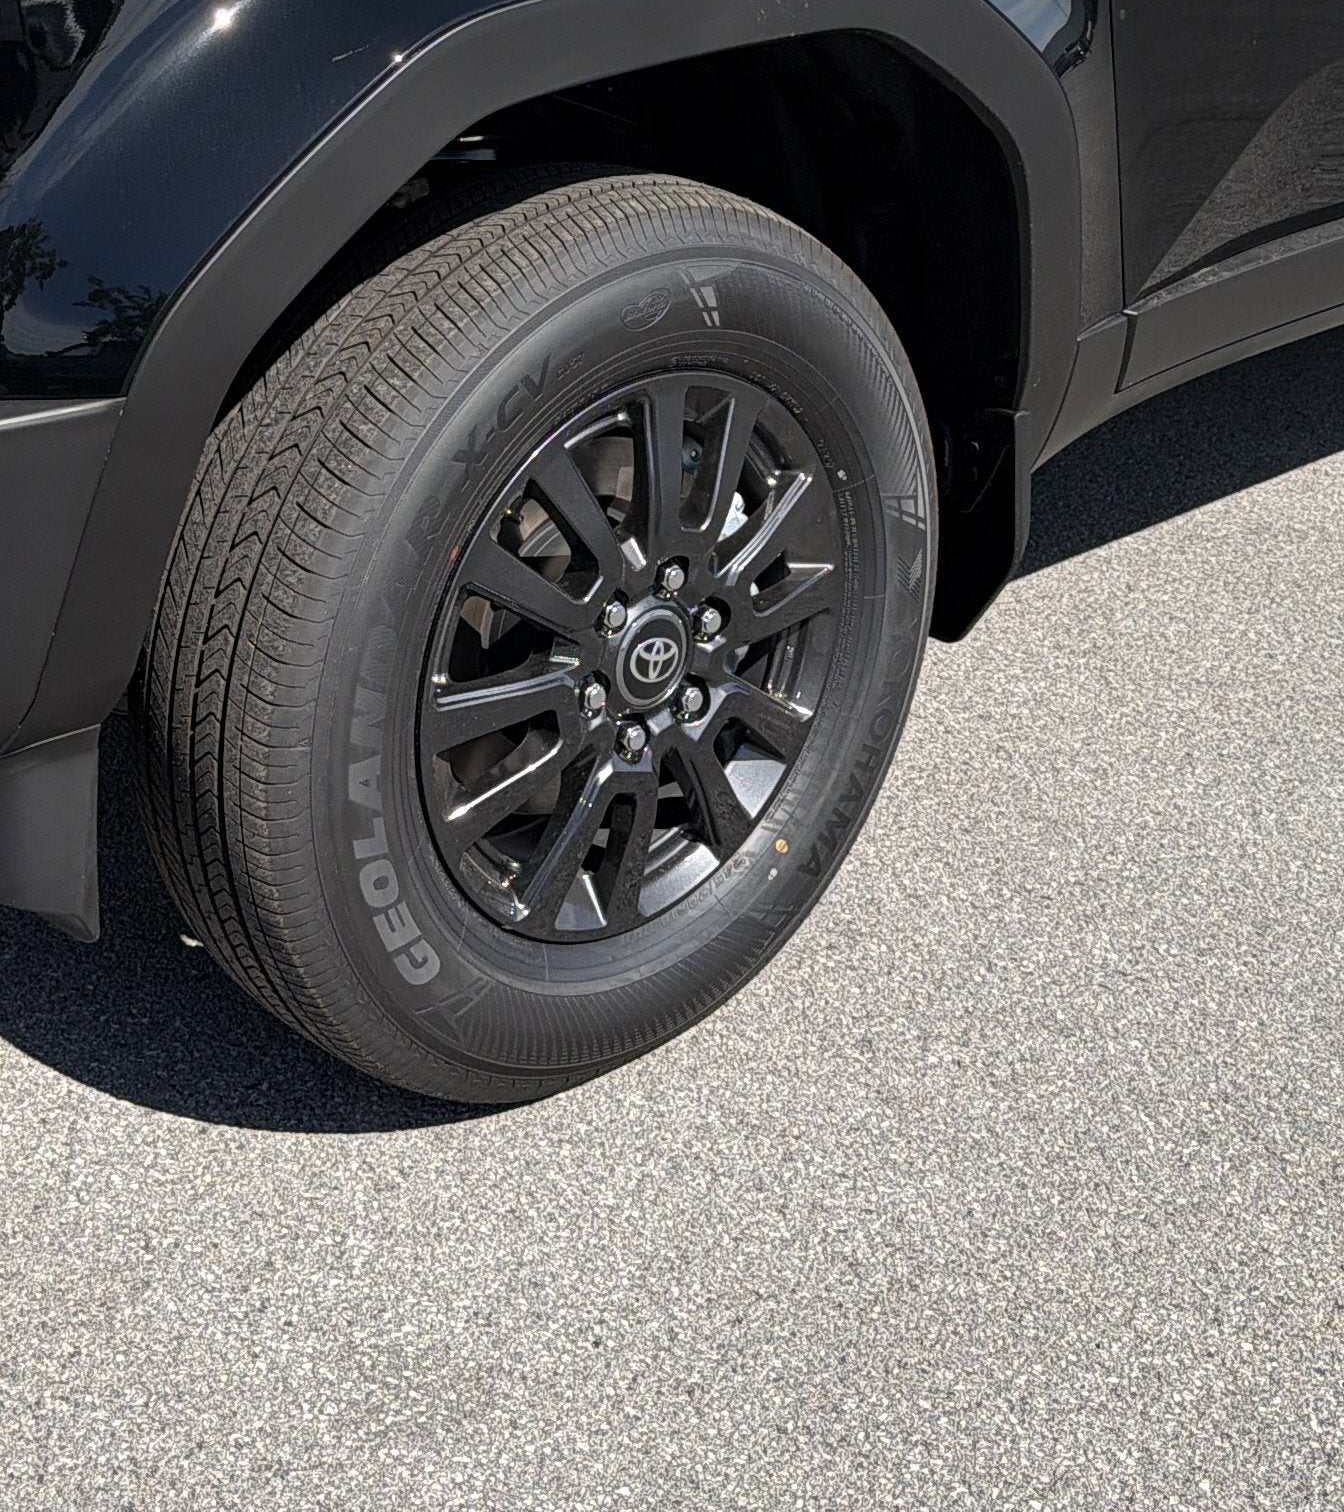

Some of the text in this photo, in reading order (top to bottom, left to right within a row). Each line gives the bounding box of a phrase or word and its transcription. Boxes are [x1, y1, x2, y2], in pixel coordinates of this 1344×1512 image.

[348, 494, 451, 986] GEOLANDAR
[451, 352, 552, 493] X-CV
[797, 610, 920, 879] YOKOHAMA
